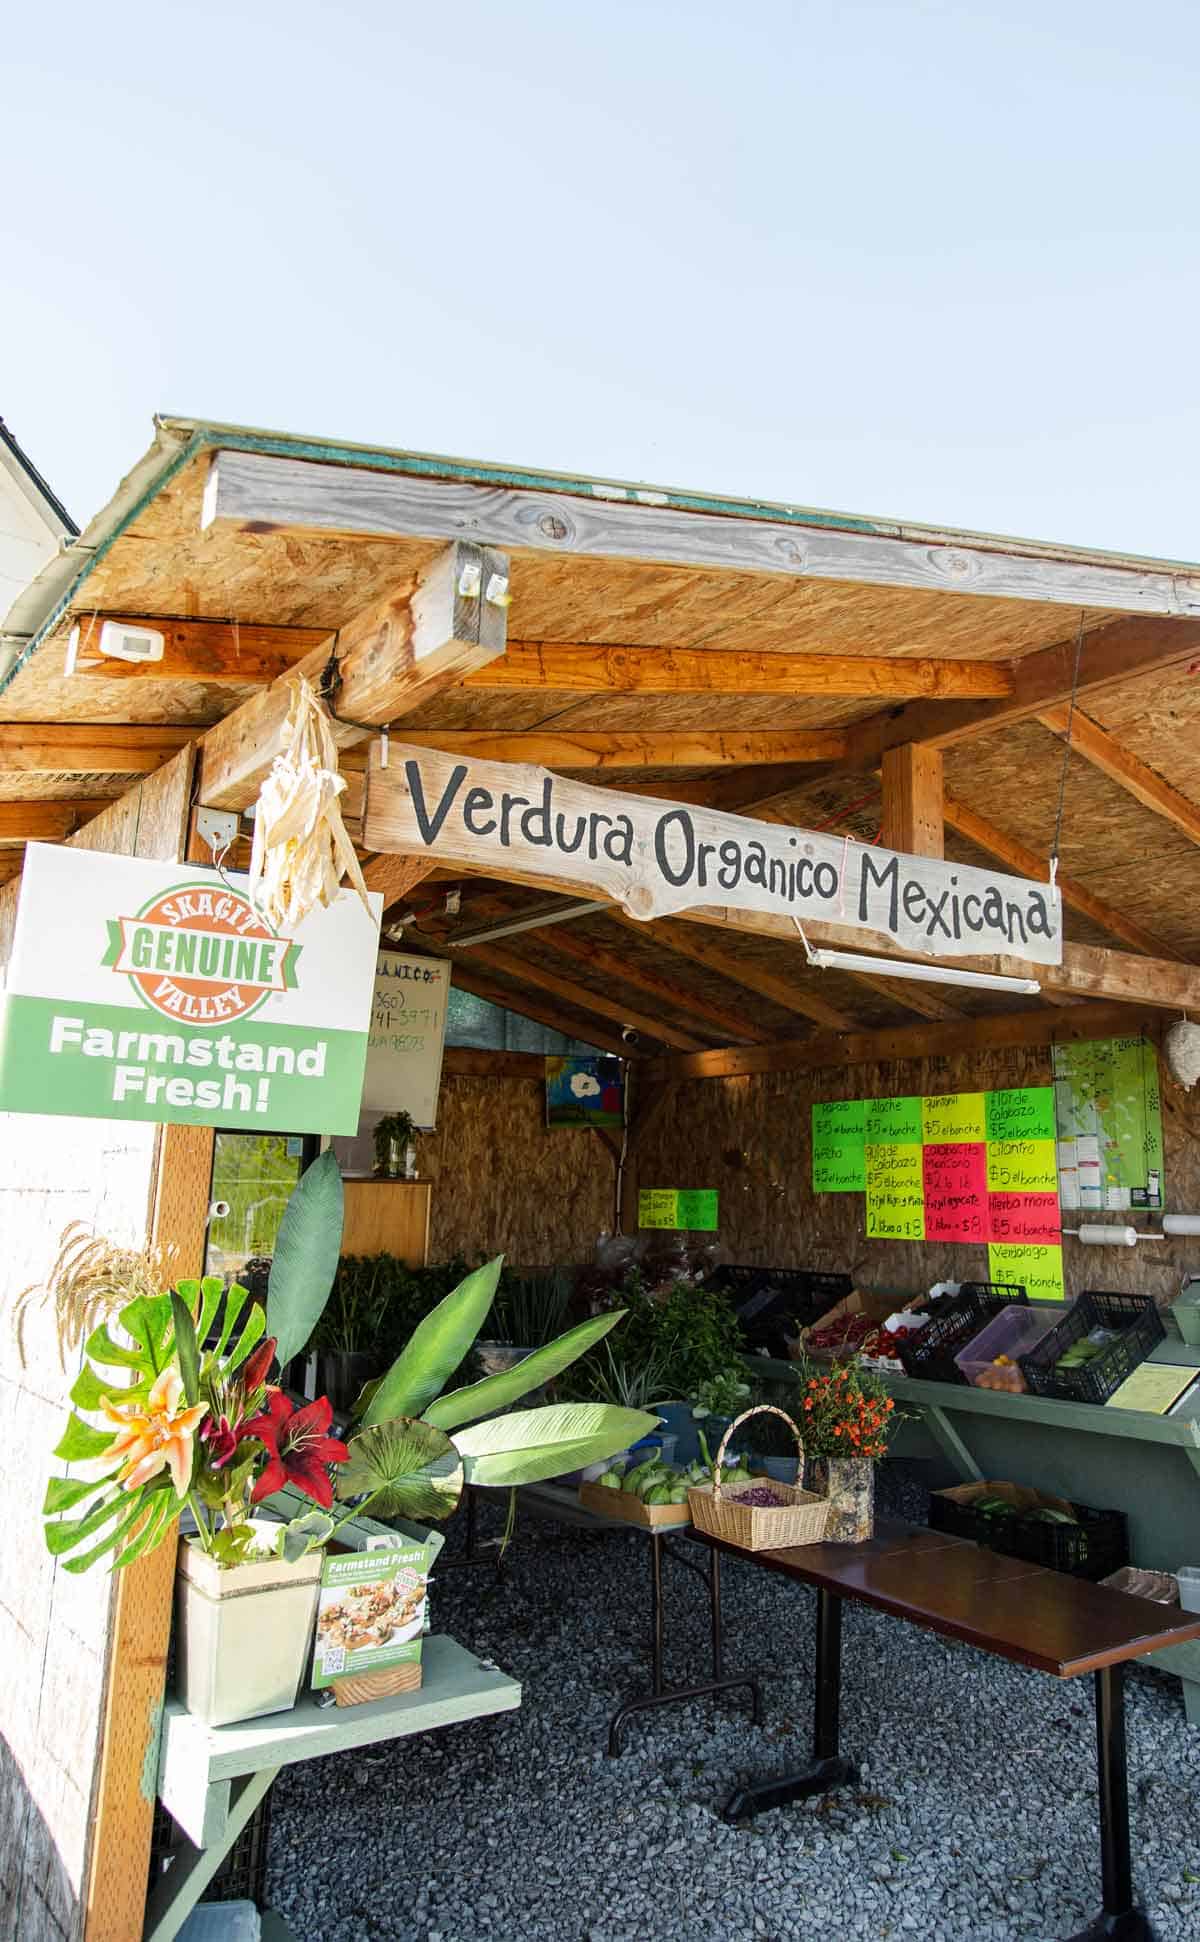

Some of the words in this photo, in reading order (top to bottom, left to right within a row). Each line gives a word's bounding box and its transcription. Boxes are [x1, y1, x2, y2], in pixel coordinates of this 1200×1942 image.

[405, 759, 634, 866] Verdura
[653, 807, 839, 902] Organico
[858, 852, 1053, 945] Mexicana
[160, 892, 267, 936] SKAGIT
[130, 926, 277, 983] GENUINE
[151, 977, 244, 1019] VALLEY
[50, 1015, 328, 1077] Farmstand
[112, 1065, 271, 1113] Fresh!
[924, 1120, 941, 1136] $5
[991, 1122, 1007, 1139] $5
[990, 1165, 1011, 1185] $5
[992, 1217, 1010, 1236] $5
[996, 1270, 1016, 1284] $5
[329, 1555, 389, 1573] Farmstand
